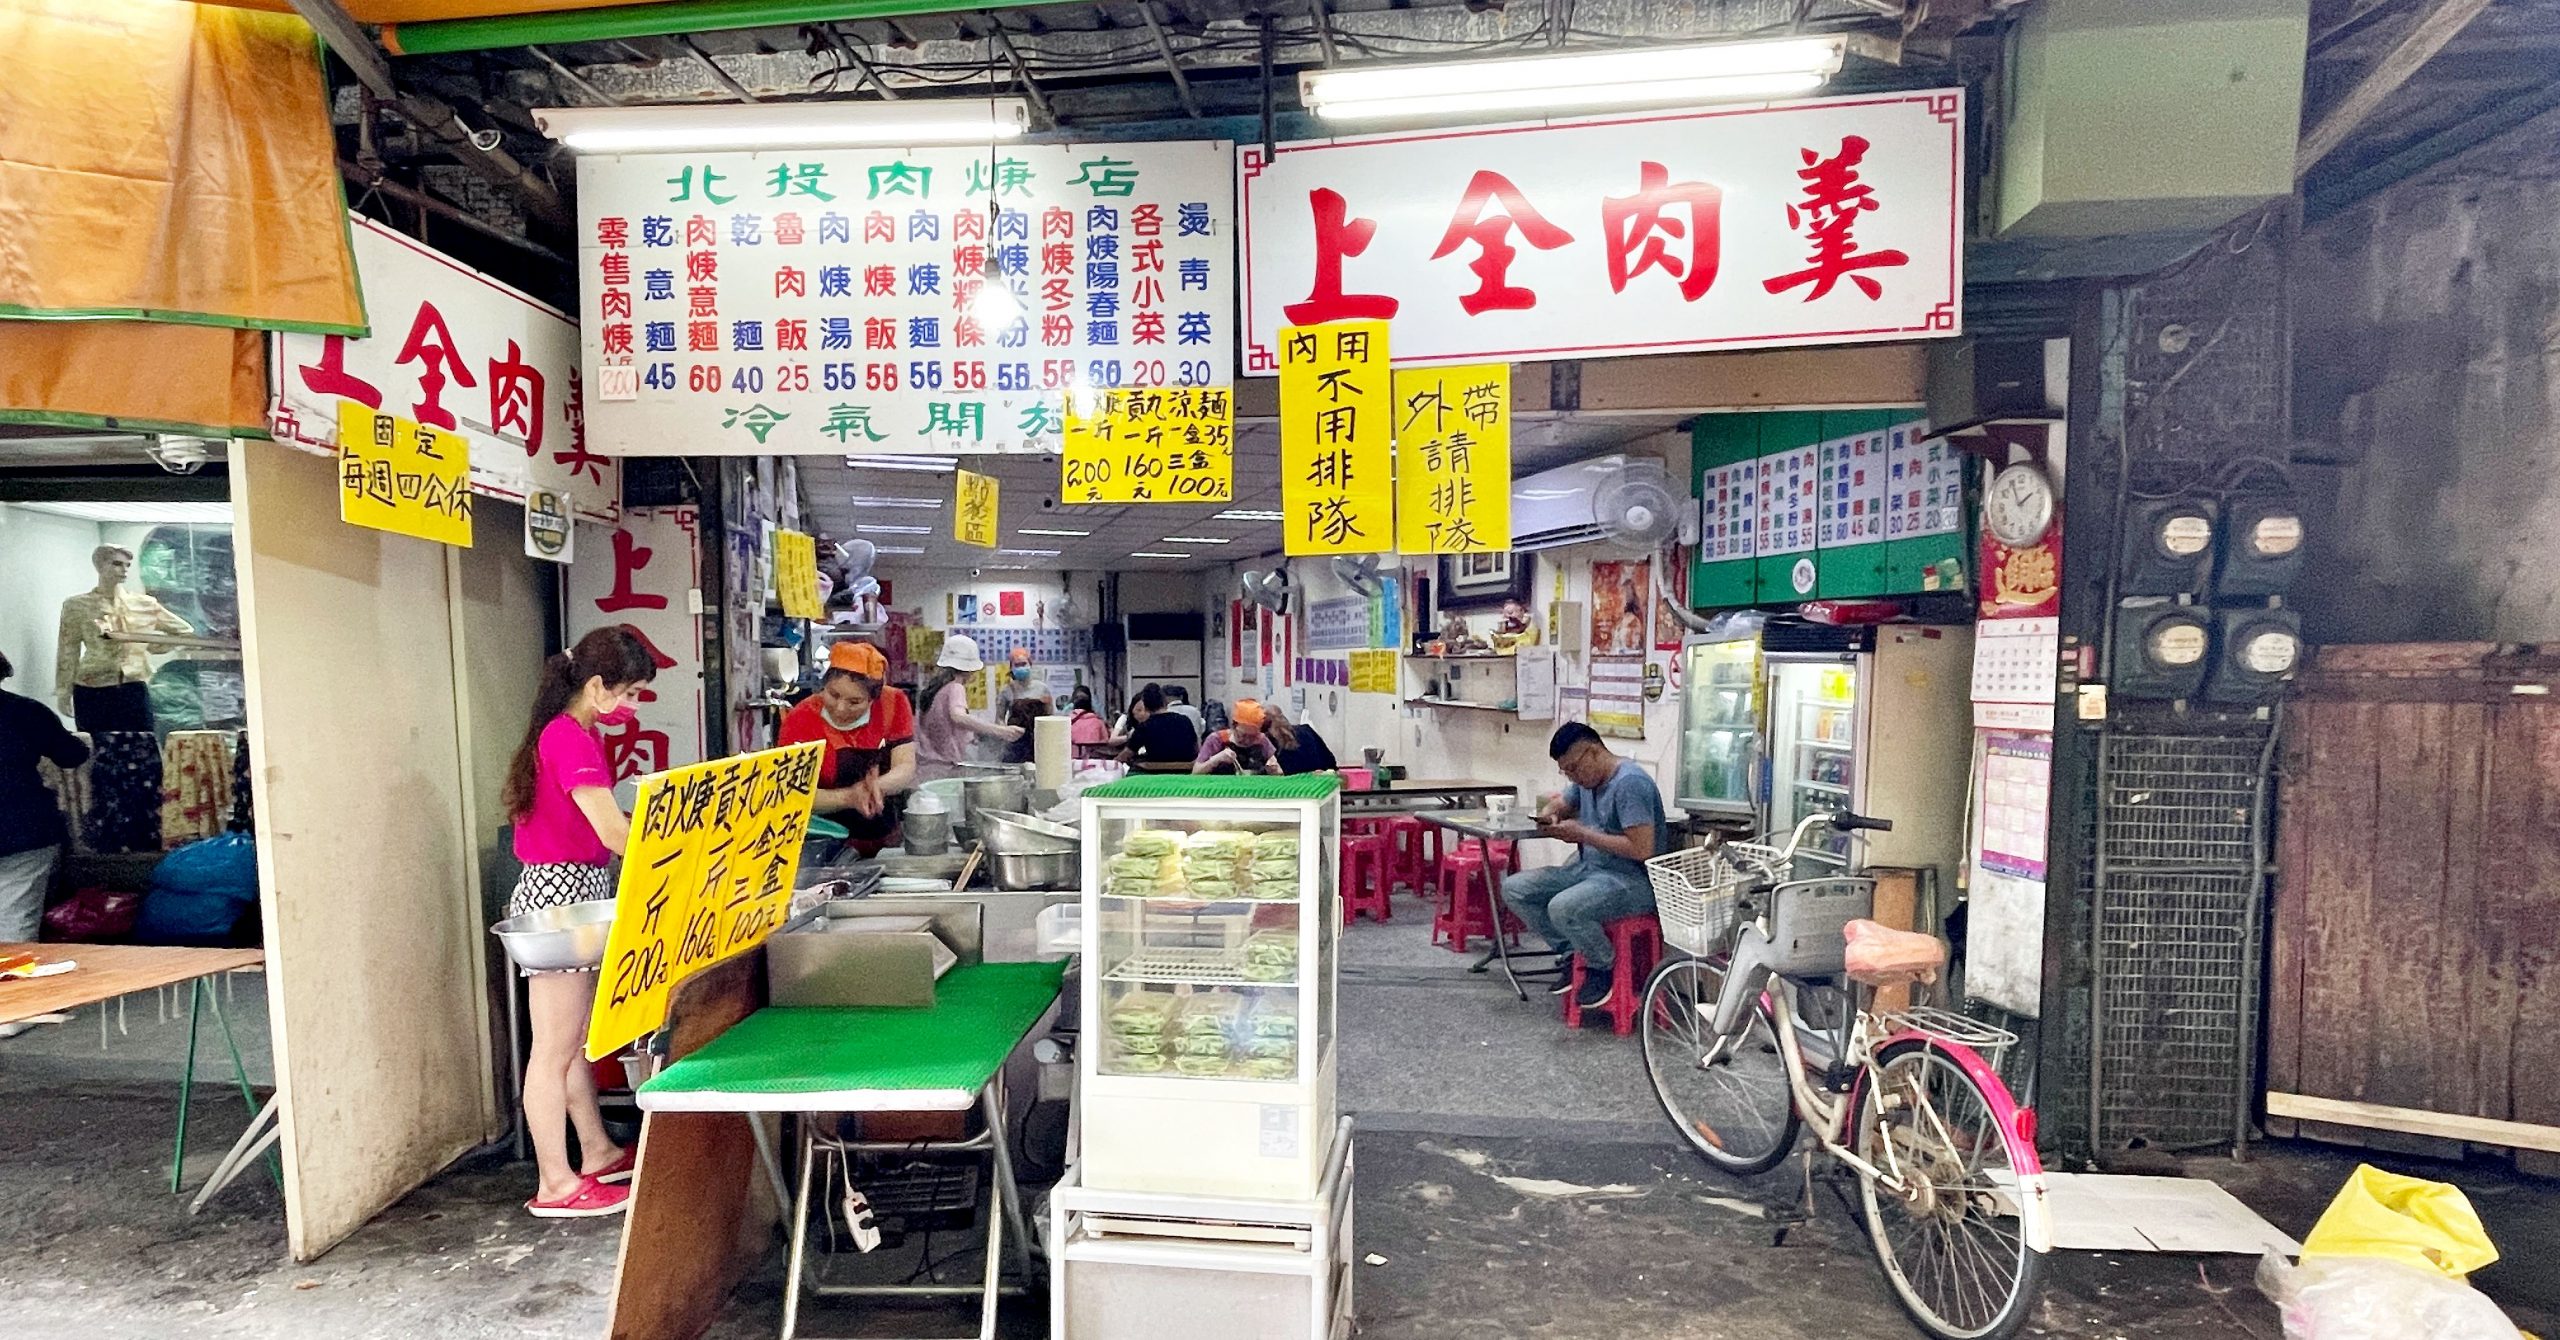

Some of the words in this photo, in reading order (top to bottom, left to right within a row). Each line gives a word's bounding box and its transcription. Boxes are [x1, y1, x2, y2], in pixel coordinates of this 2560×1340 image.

[1283, 135, 1909, 326] 上全肉羹
[642, 215, 677, 352] 乾意麵
[772, 212, 808, 352] 魯肉飯
[1130, 204, 1166, 345] 各式小菜
[1178, 202, 1211, 346] 燙青菜
[644, 363, 676, 390] 45
[689, 364, 721, 393] 60
[732, 366, 763, 393] 40
[777, 364, 809, 392] 25
[1133, 360, 1165, 387] 20
[1178, 360, 1210, 387] 30
[1127, 391, 1166, 422] 貢丸
[1168, 390, 1227, 421] 涼麵
[1402, 379, 1501, 432] 外帶
[373, 415, 444, 460] 固定
[1124, 425, 1164, 448] 一斤
[1306, 369, 1365, 545] 不用排隊
[341, 446, 473, 522] 每週四公休
[1420, 429, 1486, 553] 請排隊
[1906, 512, 1920, 530] 25
